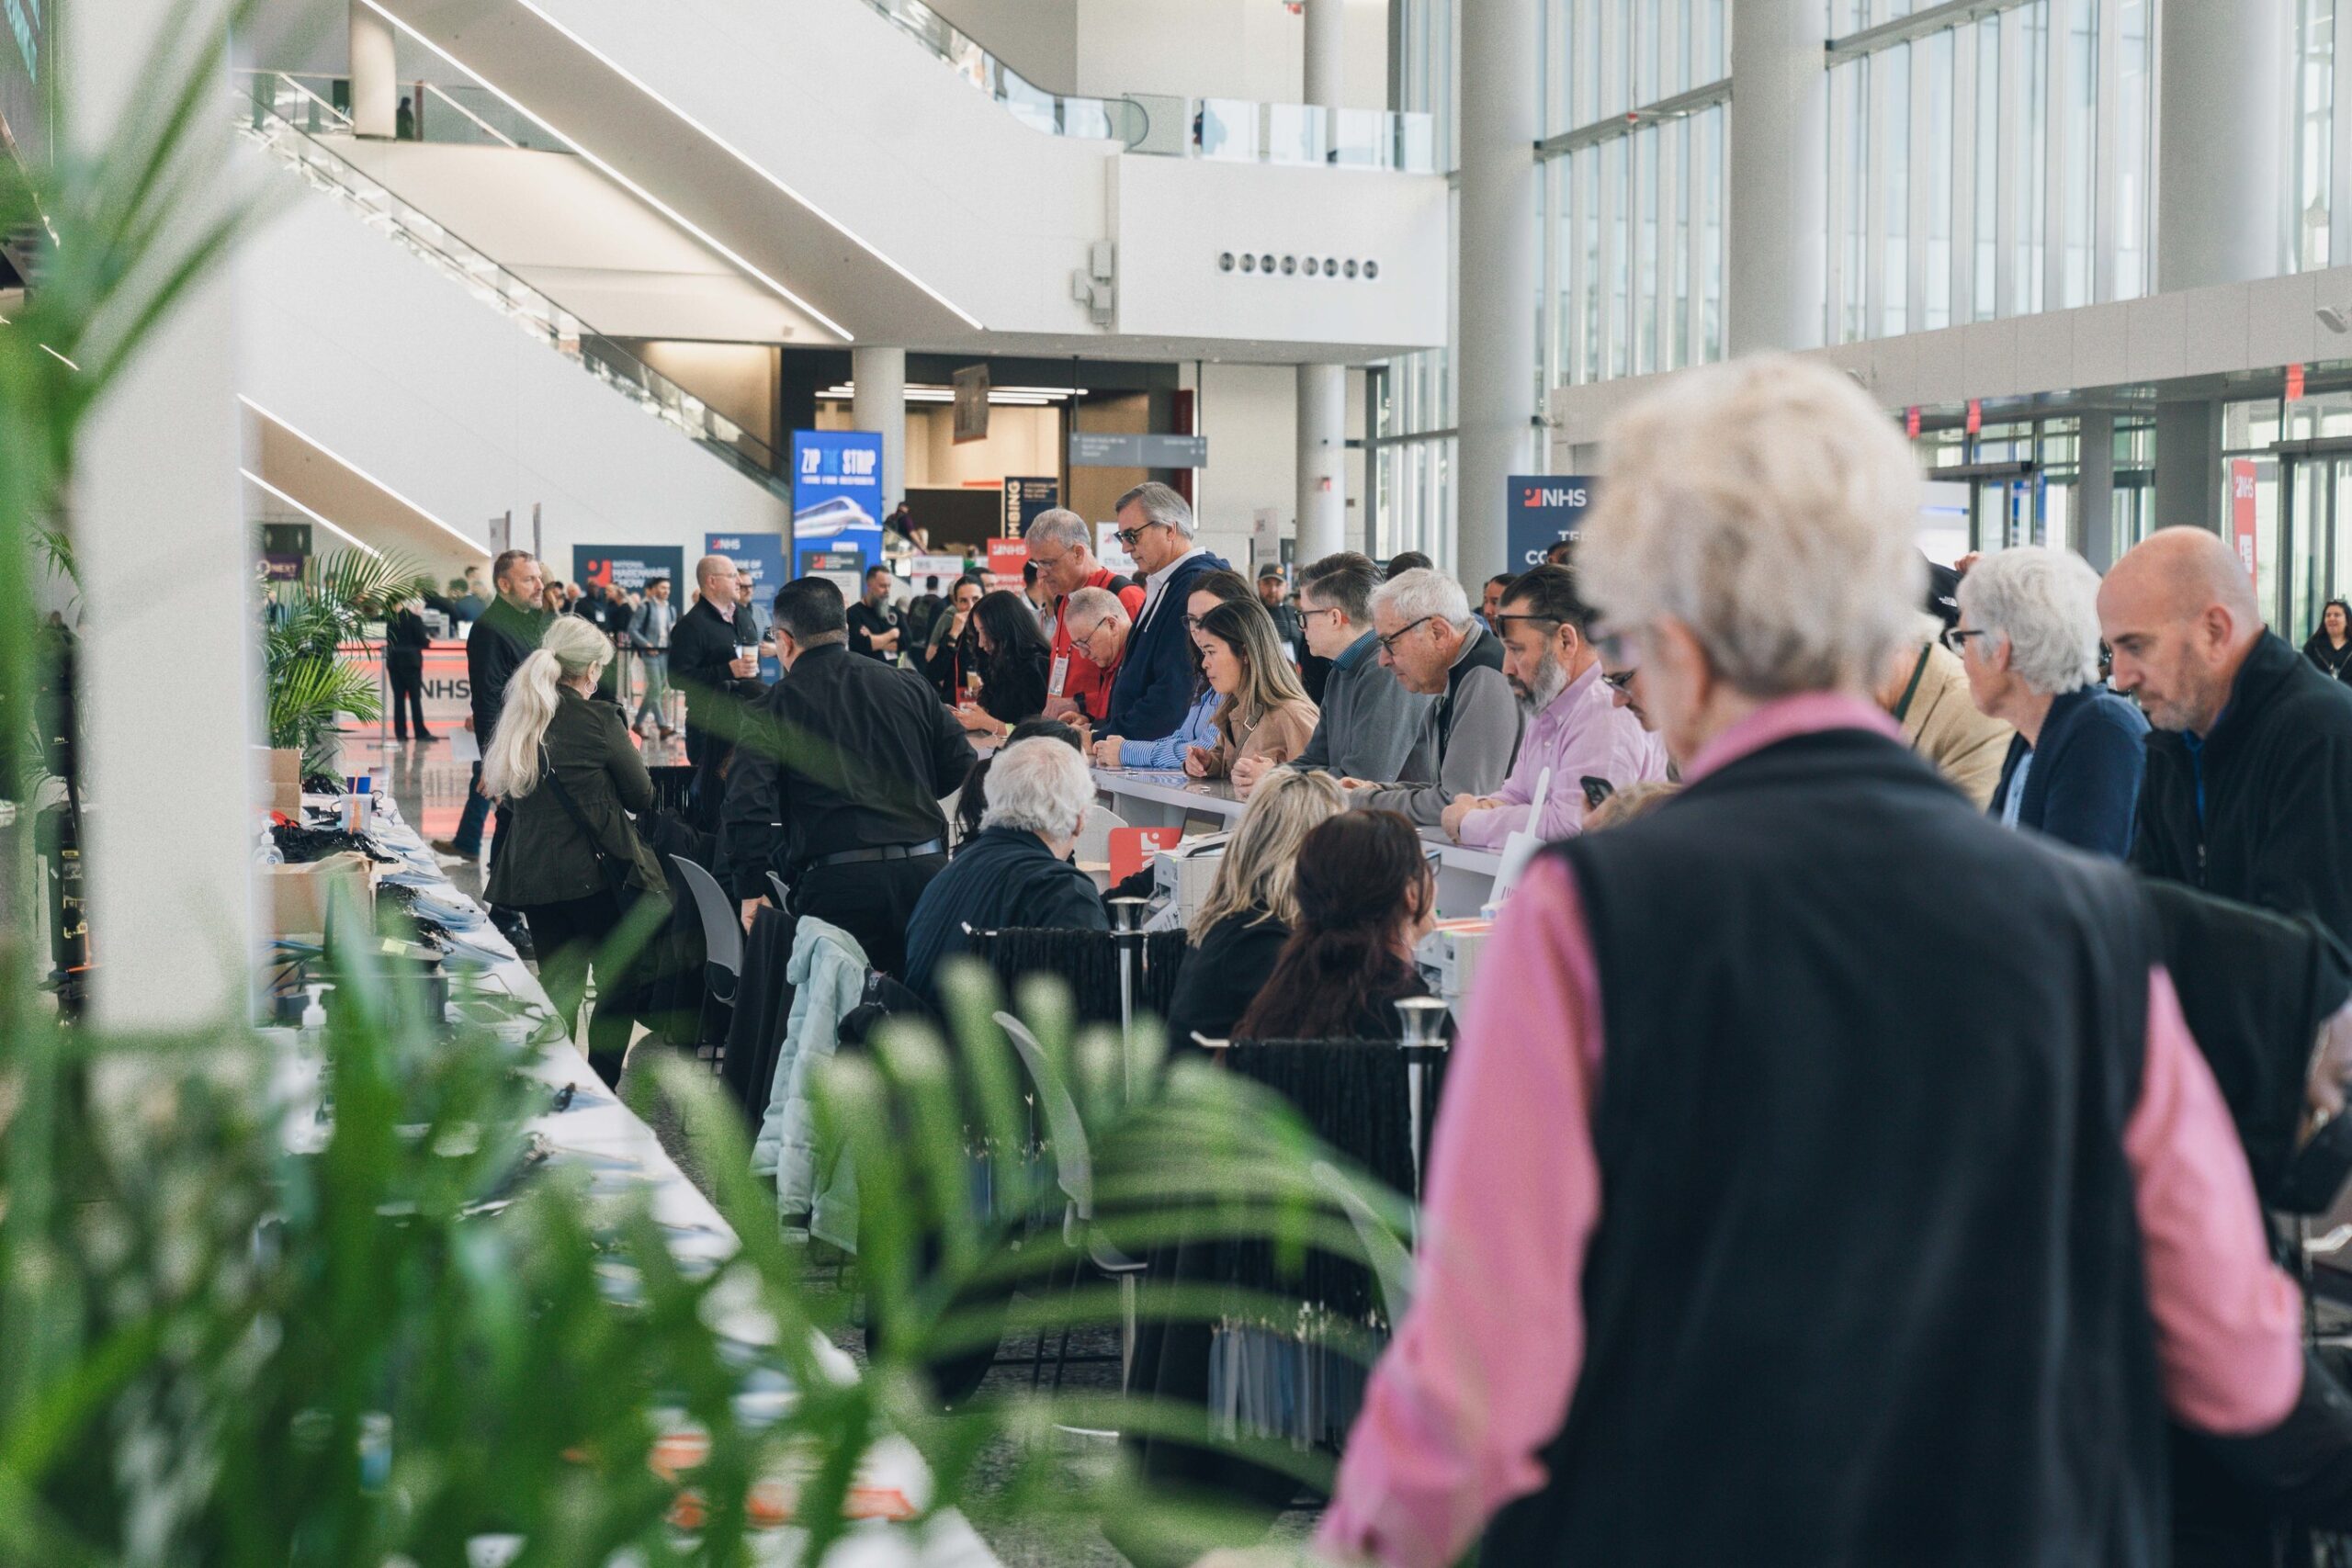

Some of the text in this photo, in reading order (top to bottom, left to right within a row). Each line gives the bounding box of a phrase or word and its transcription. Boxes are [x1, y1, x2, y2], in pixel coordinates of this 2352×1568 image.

[801, 448, 820, 473] ZIP
[1542, 489, 1587, 507] NHS
[1008, 480, 1021, 539] MBING
[720, 538, 741, 550] NHS
[1001, 544, 1027, 555] NHS
[421, 679, 470, 699] NHS
